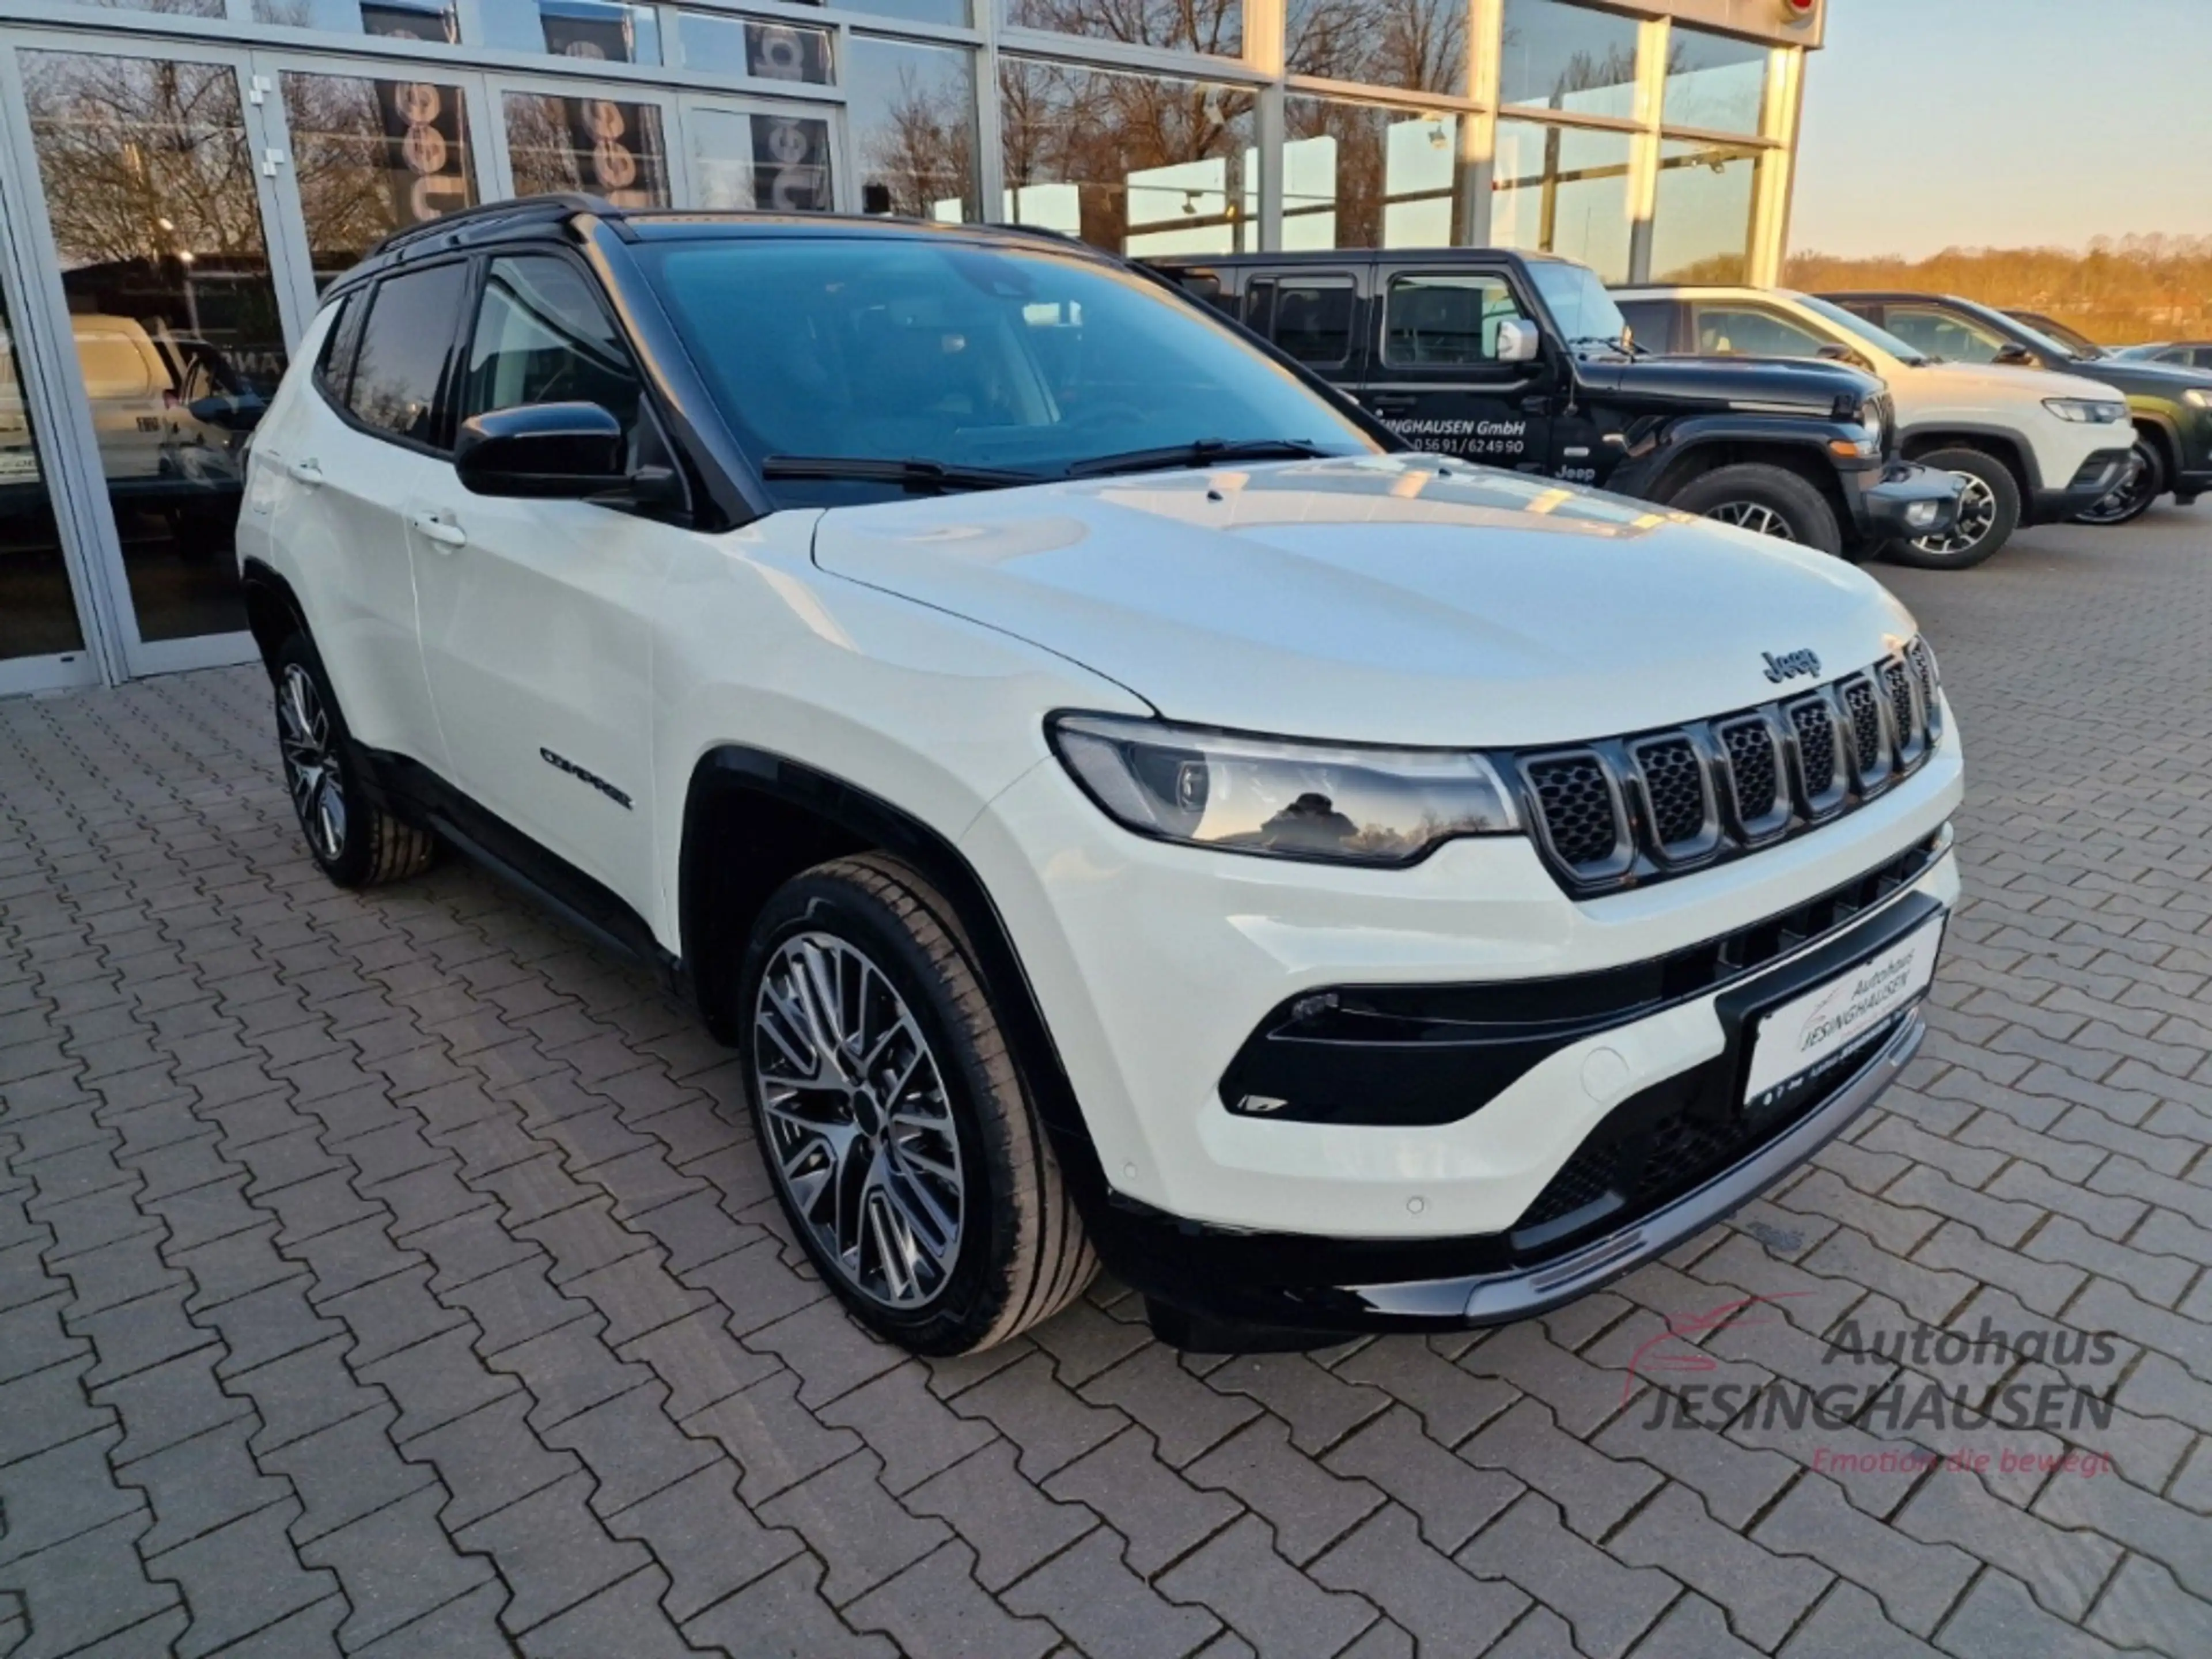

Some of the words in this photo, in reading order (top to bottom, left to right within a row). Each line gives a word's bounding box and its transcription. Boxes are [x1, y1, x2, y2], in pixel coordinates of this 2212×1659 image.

[1477, 421, 1525, 436] GmbH
[1555, 464, 1596, 482] Jeep
[1761, 649, 1821, 684] Jeep
